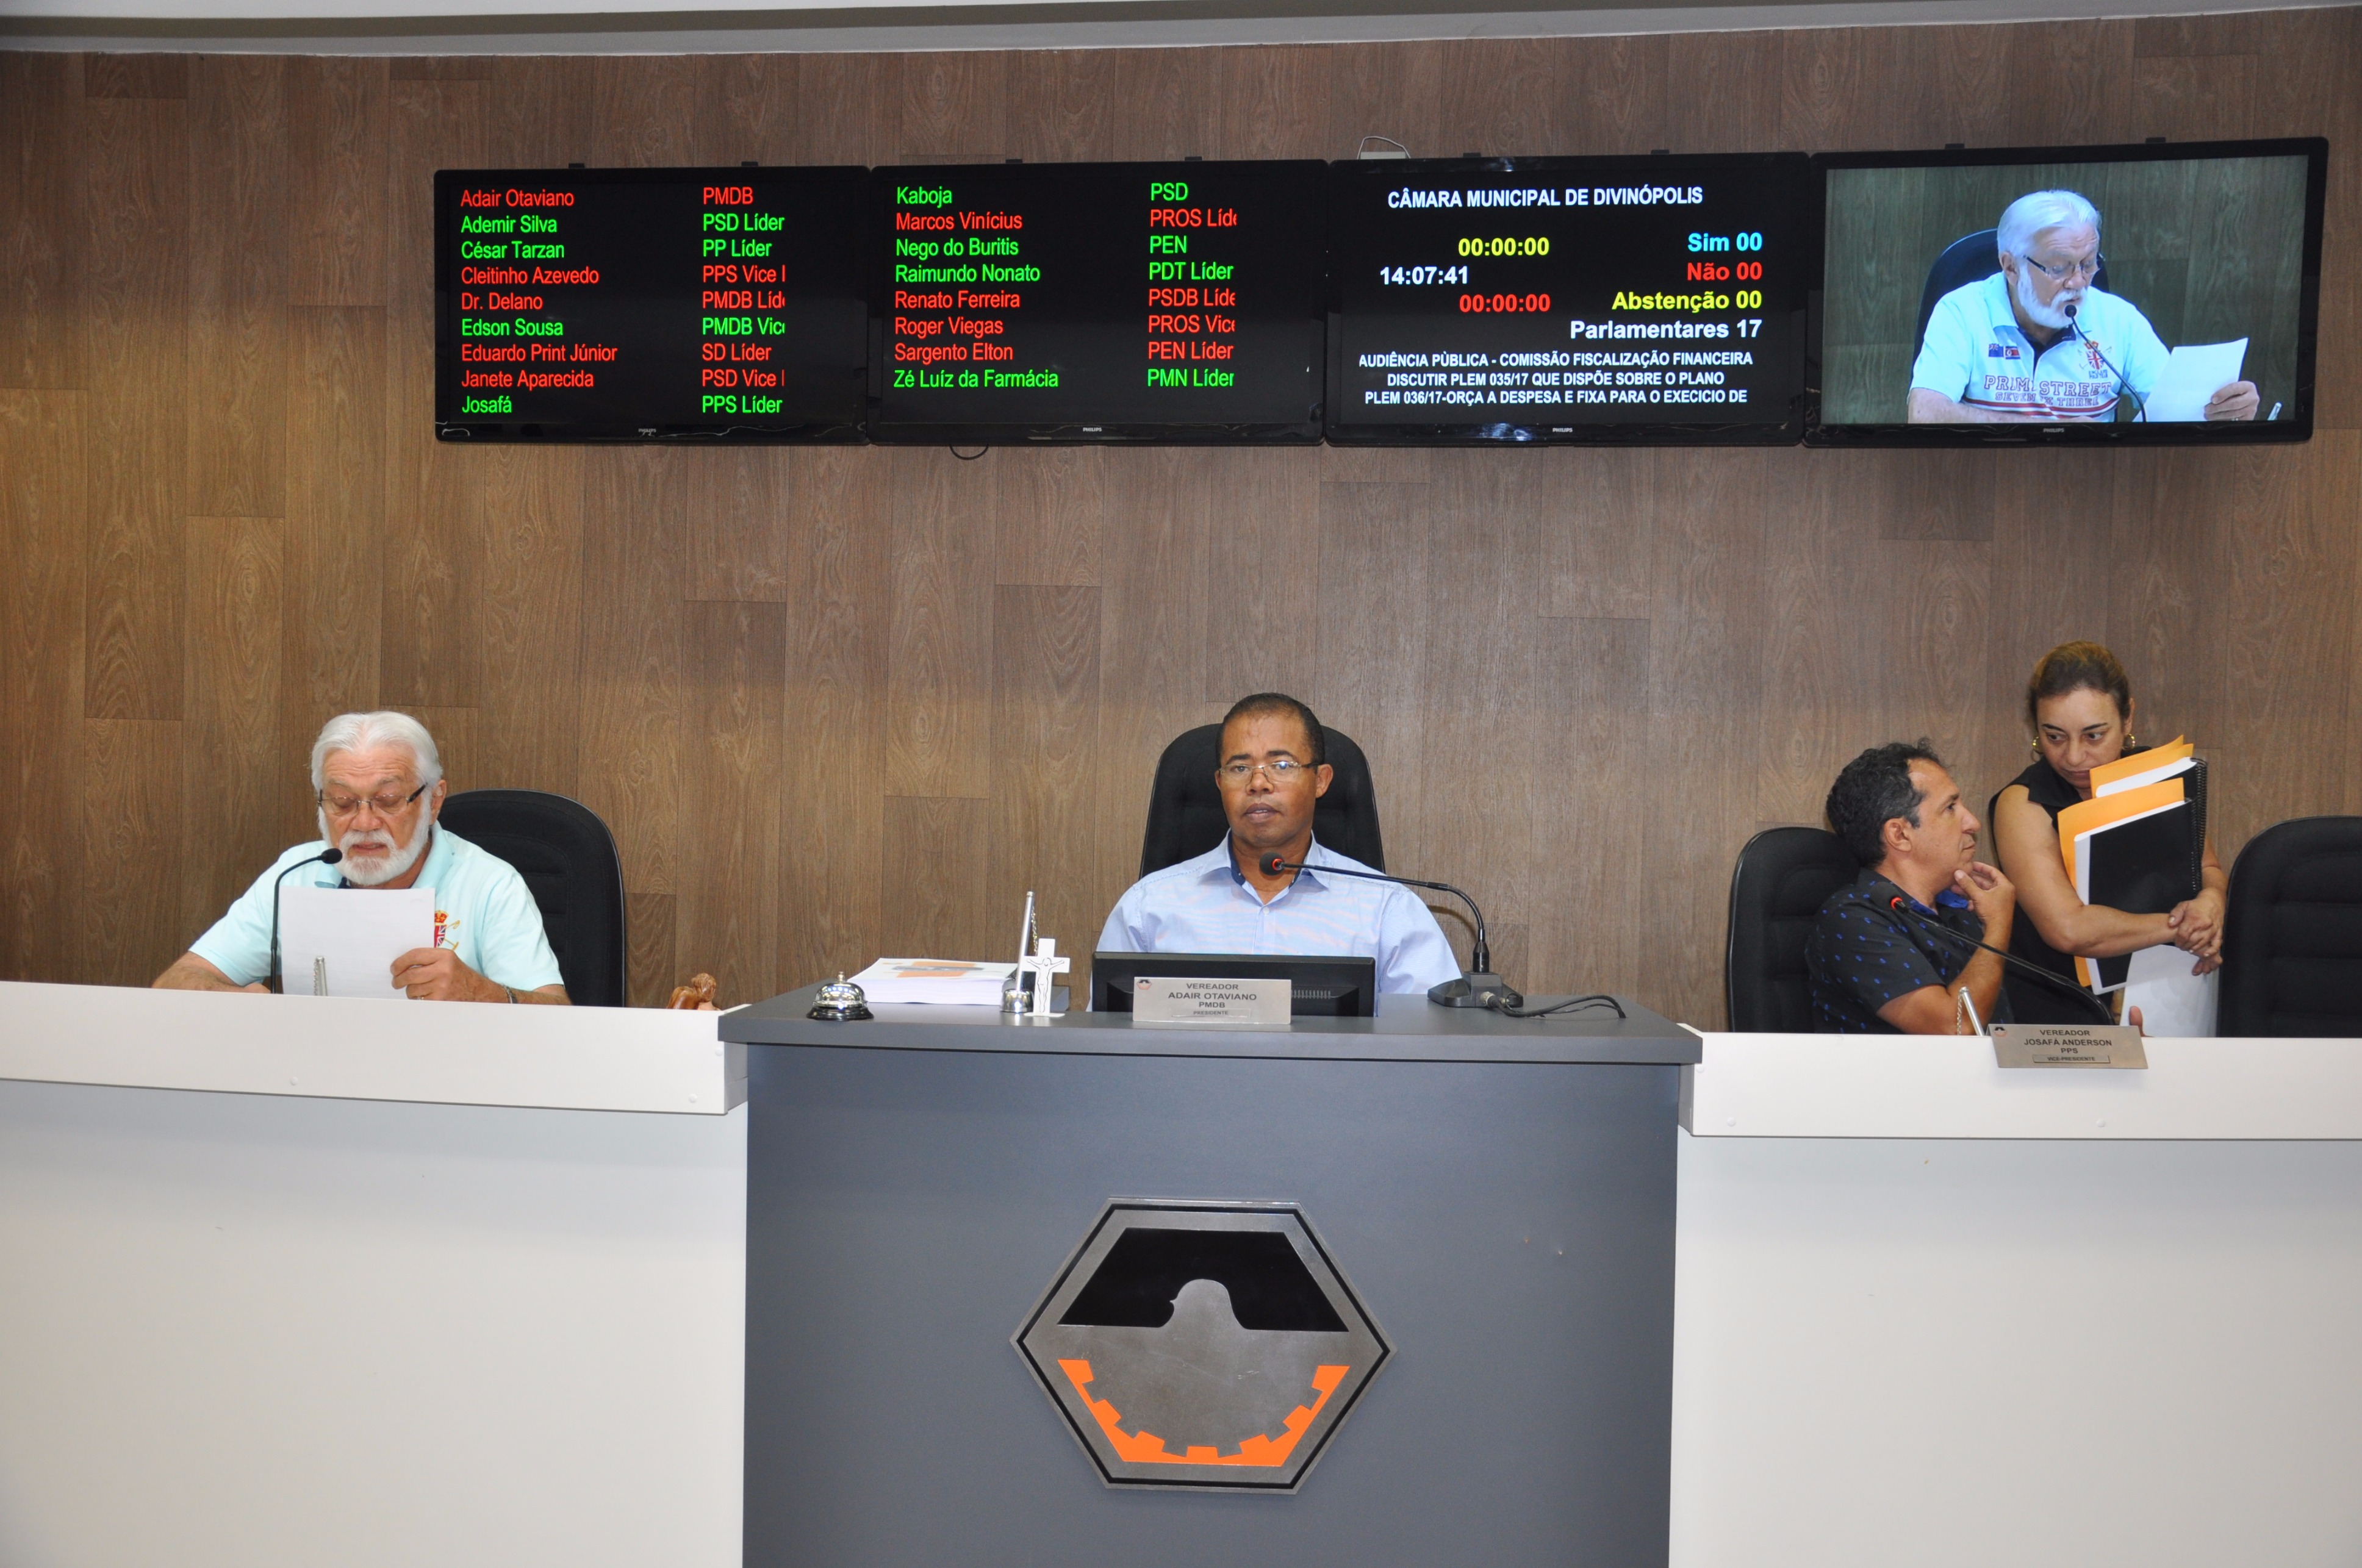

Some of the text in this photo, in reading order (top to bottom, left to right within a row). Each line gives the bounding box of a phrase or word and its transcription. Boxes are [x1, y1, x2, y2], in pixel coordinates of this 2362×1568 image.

[461, 189, 574, 207] Adair Otaviano
[703, 187, 753, 205] PMDB
[897, 186, 952, 208] Kaboja
[1151, 183, 1188, 201] PSD
[1388, 184, 1703, 208] CÂMARA MUNICIPAL DE DIVINÓPOLIS
[461, 215, 557, 233] Ademir Silva
[703, 213, 784, 231] PSD Líder
[897, 212, 1022, 231] Marcos Vinícius
[1150, 209, 1202, 227] PROS
[462, 241, 564, 259] César Tarzan
[703, 239, 772, 257] PP Líder
[897, 237, 1019, 260] Nego do Buritis
[1150, 235, 1186, 254] PEN
[1459, 237, 1549, 256] 00:00:00
[1688, 232, 1762, 252] Sim 00
[462, 266, 600, 284] Cleitinho Azevedo
[703, 265, 738, 283] PPS
[742, 265, 777, 282] Vice
[896, 264, 1040, 282] Raimundo Nonato
[1150, 262, 1233, 280] PDT Líder
[1380, 266, 1468, 285] 14:07:41
[1687, 262, 1762, 281] Não 00
[462, 292, 543, 310] Dr. Delano
[703, 291, 753, 309] PMDB
[896, 290, 1020, 309] Renato Ferreira
[1149, 288, 1199, 307] PSDB
[1460, 294, 1551, 312] 00:00:00
[1612, 290, 1762, 313] Abstenção 00
[462, 318, 563, 335] Edson Sousa
[703, 317, 752, 335] PMDB
[896, 317, 1003, 339] Roger Viegas
[1149, 315, 1201, 333] PROS
[1571, 319, 1762, 339] Parlamentares 17
[462, 343, 618, 361] Eduardo Print Júnior
[702, 343, 772, 361] SD Líder
[895, 343, 1013, 365] Sargento Elton
[1149, 342, 1234, 360] PEN Líder
[1359, 351, 1429, 367] AUDIÊNCIA
[1499, 350, 1570, 367] COMISSÃO
[1573, 350, 1670, 368] FISCALIZAÇÃO
[1673, 352, 1753, 365] FINANCEIRA
[462, 370, 594, 391] Janete Aparecida
[702, 369, 738, 387] PSD
[742, 369, 777, 387] Vice
[894, 370, 1058, 387] Zé Luíz da Farmácia
[1148, 368, 1234, 387] PMN Líder
[1388, 370, 1725, 386] DISCUTIR PLEM 035/17 QUE DISPÕE SOBRE O PLANO
[1365, 389, 1747, 406] PLEM 036/17-ORÇA A DESPESA E FIXA PARA O EXECICIO DE
[2039, 381, 2111, 397] STREET
[462, 395, 512, 413] Josafá
[703, 395, 783, 413] PPS Líder
